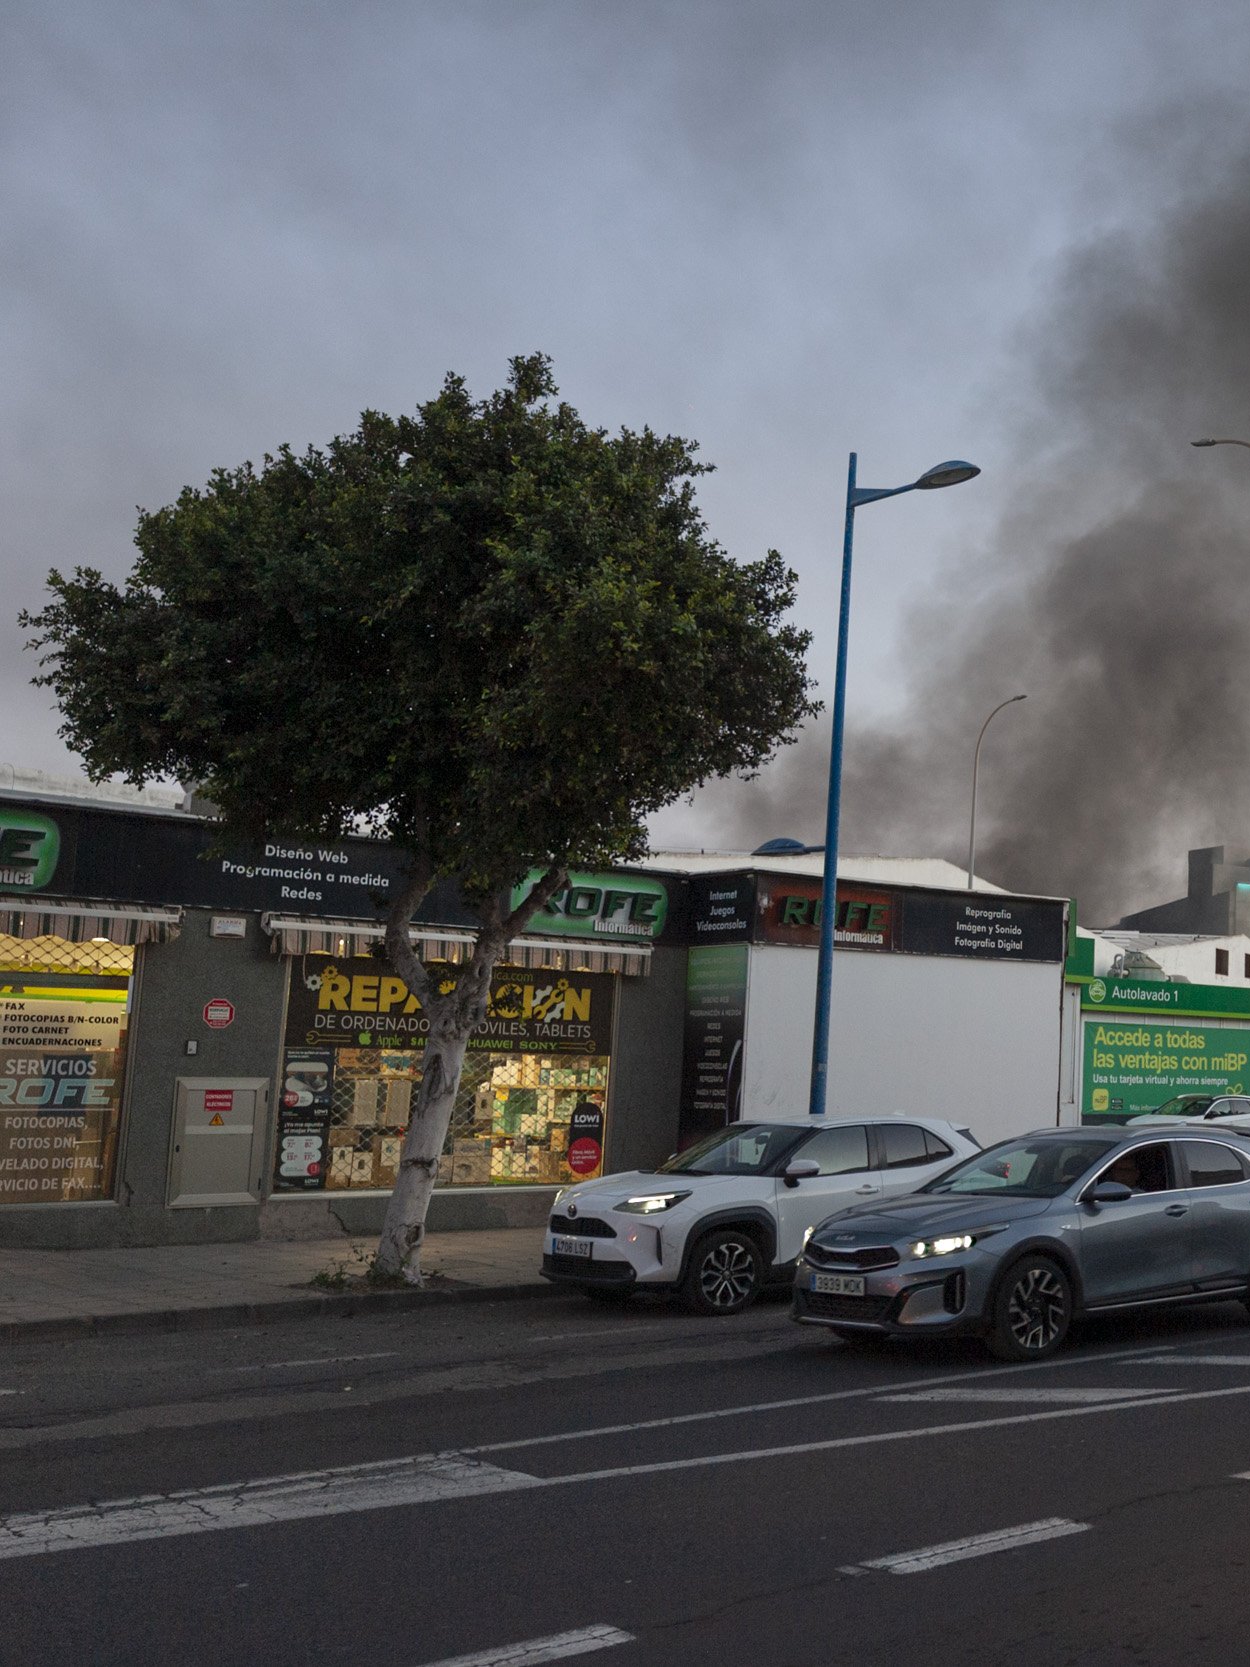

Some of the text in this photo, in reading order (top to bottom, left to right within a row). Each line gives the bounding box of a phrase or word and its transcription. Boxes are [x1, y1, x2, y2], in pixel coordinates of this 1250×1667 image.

[0, 828, 46, 867] E
[265, 844, 348, 864] Diseño Web
[0, 867, 34, 885] tica
[222, 861, 389, 888] Programación a medida
[281, 886, 322, 901] Redes
[710, 889, 738, 901] Internet
[710, 906, 735, 917] Juegos
[697, 919, 747, 932] Videoconsolas
[988, 926, 993, 935] y
[995, 924, 1022, 935] Sonido
[997, 939, 1023, 951] Digital
[1112, 986, 1179, 1002] Autolavado 1
[4, 1014, 119, 1024] FOTOCOPIAS B/N-COLOR
[315, 1014, 336, 1028] DE
[535, 1023, 591, 1038] TABLETS
[32, 1026, 69, 1034] CARNET
[2, 1037, 102, 1046] ENCUADERNACIONES
[376, 1033, 402, 1048] Apple
[468, 1039, 513, 1049] HUAWEI
[520, 1041, 558, 1050] SONY
[1094, 1026, 1205, 1049] Accede a todas
[5, 1059, 97, 1076] SERVICIOS
[1093, 1048, 1248, 1074] las ventajas con miBP
[1092, 1074, 1229, 1087] Usa tu tarjeta virtual y ahorra siempre
[5, 1116, 88, 1130] FOTOCOPIAS,
[574, 1114, 600, 1123] LOWI
[9, 1136, 79, 1151] FOTOS DNI,
[52, 1157, 104, 1169] DIGITAL,
[42, 1178, 58, 1189] DE
[817, 1276, 841, 1290] 3939
